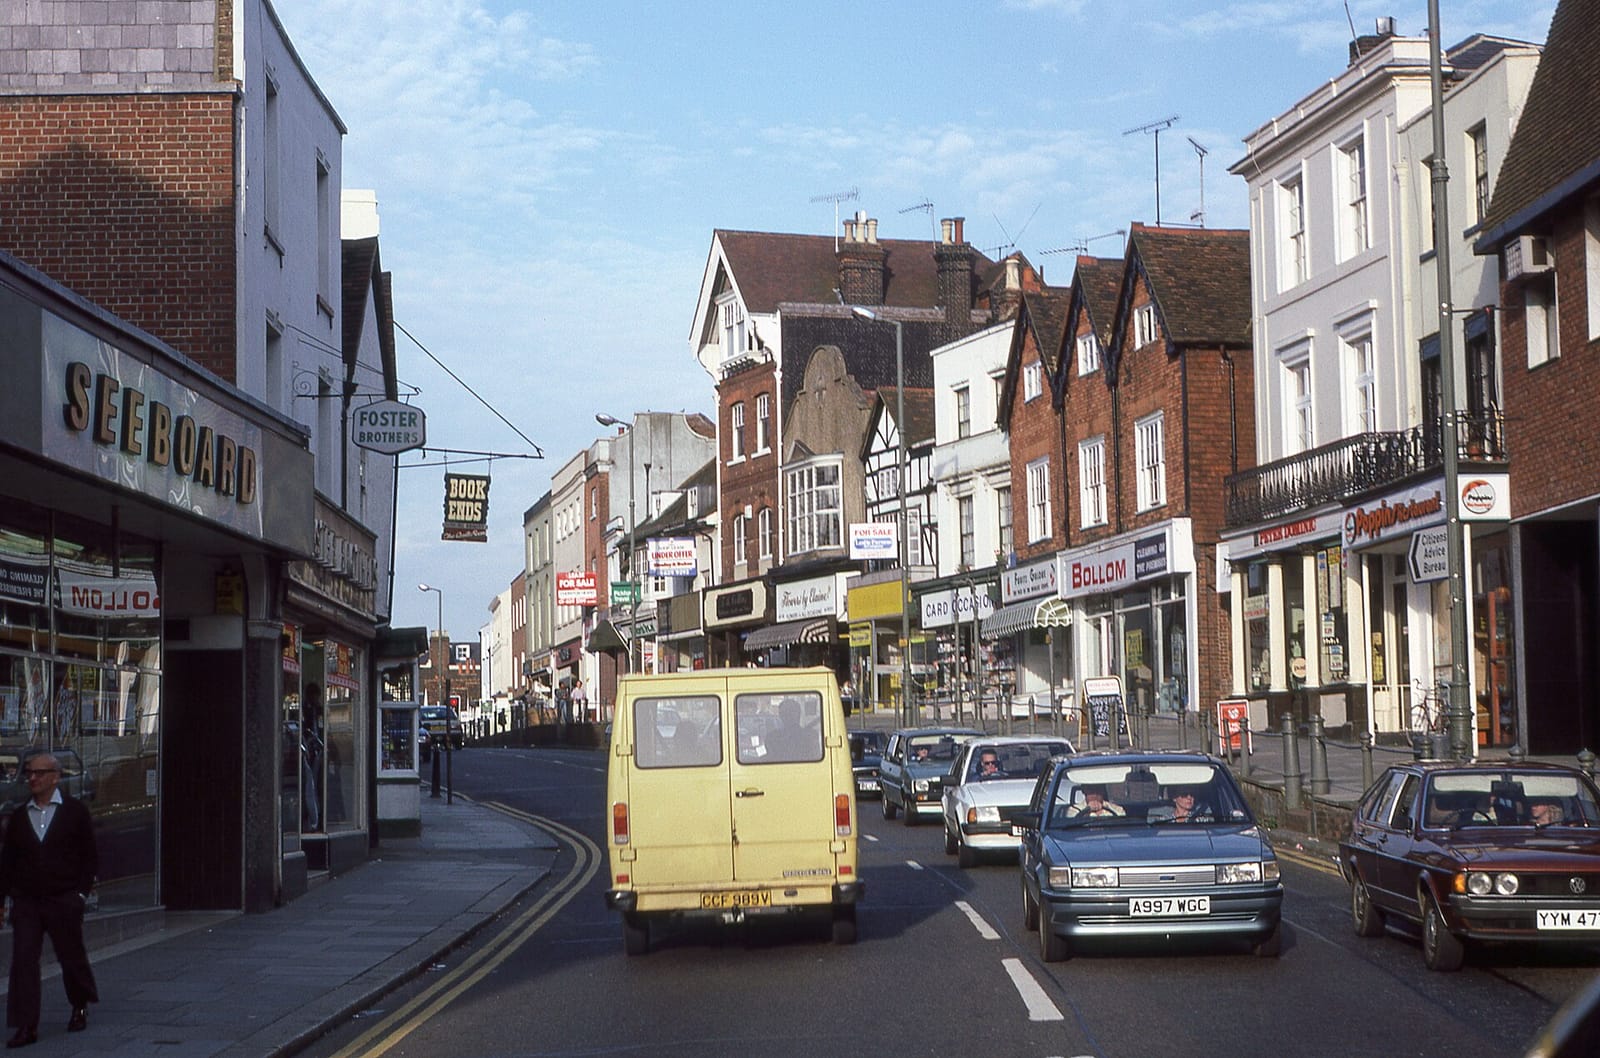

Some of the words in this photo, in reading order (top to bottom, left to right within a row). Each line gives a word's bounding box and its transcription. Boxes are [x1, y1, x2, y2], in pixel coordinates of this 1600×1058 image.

[360, 411, 418, 427] FOSTER
[63, 361, 257, 505] SEEBOARD
[359, 431, 418, 443] BROTHERS
[449, 478, 487, 500] BOOK
[448, 500, 482, 521] ENDS
[1422, 533, 1447, 546] Citizens
[1424, 547, 1446, 559] Advice
[1072, 558, 1127, 589] BOLLOM
[1424, 562, 1446, 574] Bureau
[559, 580, 575, 588] FOR
[576, 579, 595, 587] SALE
[926, 602, 948, 617] CARD
[702, 895, 730, 907] CCF
[1132, 899, 1173, 913] A997
[1178, 899, 1208, 912] WGC
[1539, 912, 1571, 926] YYM
[1577, 912, 1600, 926] 47
